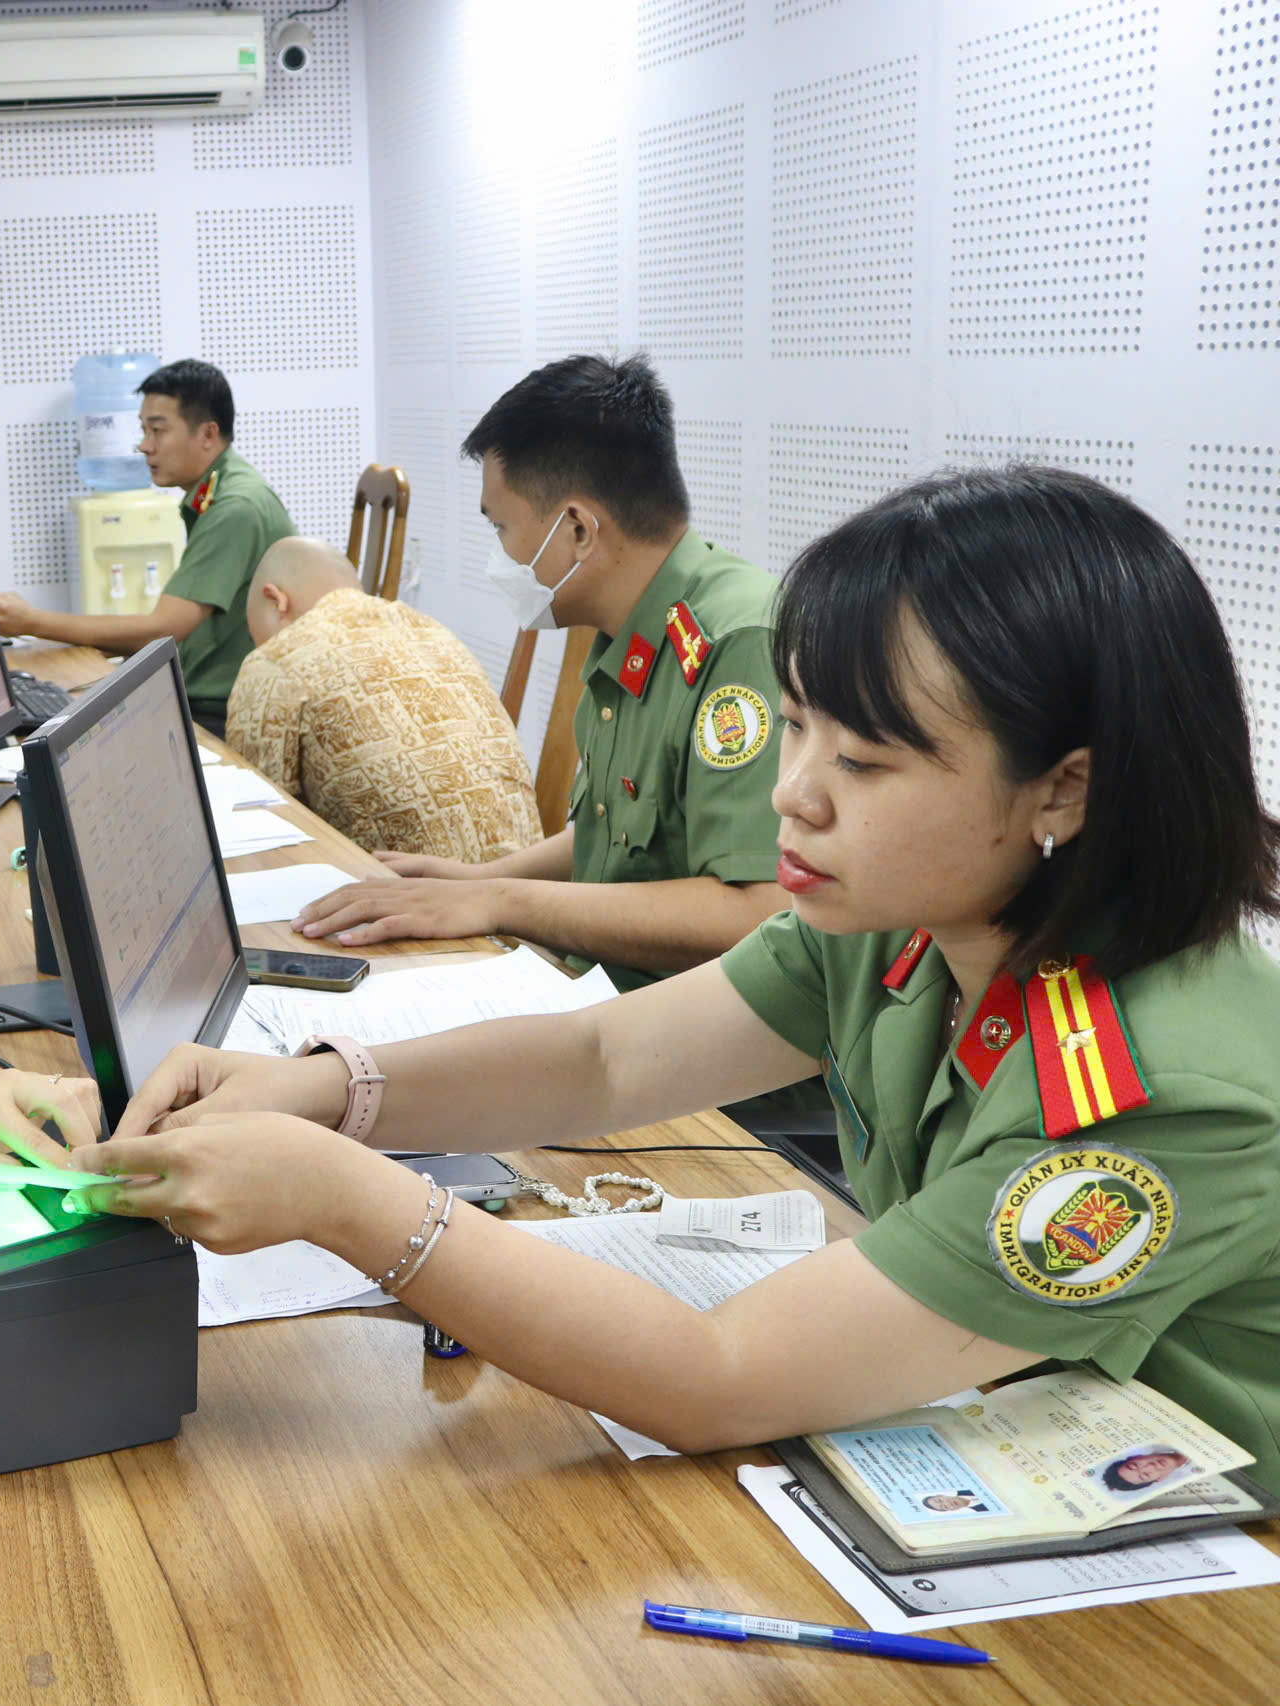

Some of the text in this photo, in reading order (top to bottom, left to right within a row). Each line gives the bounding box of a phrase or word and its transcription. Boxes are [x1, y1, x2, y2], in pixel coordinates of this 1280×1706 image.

[708, 735, 765, 765] IMMIGRATION
[740, 1211, 760, 1233] 274
[1010, 1151, 1172, 1281] QUẢN LÝ XUẤT NHẬP CẢNH
[999, 1222, 1102, 1298] IMMIGRATION
